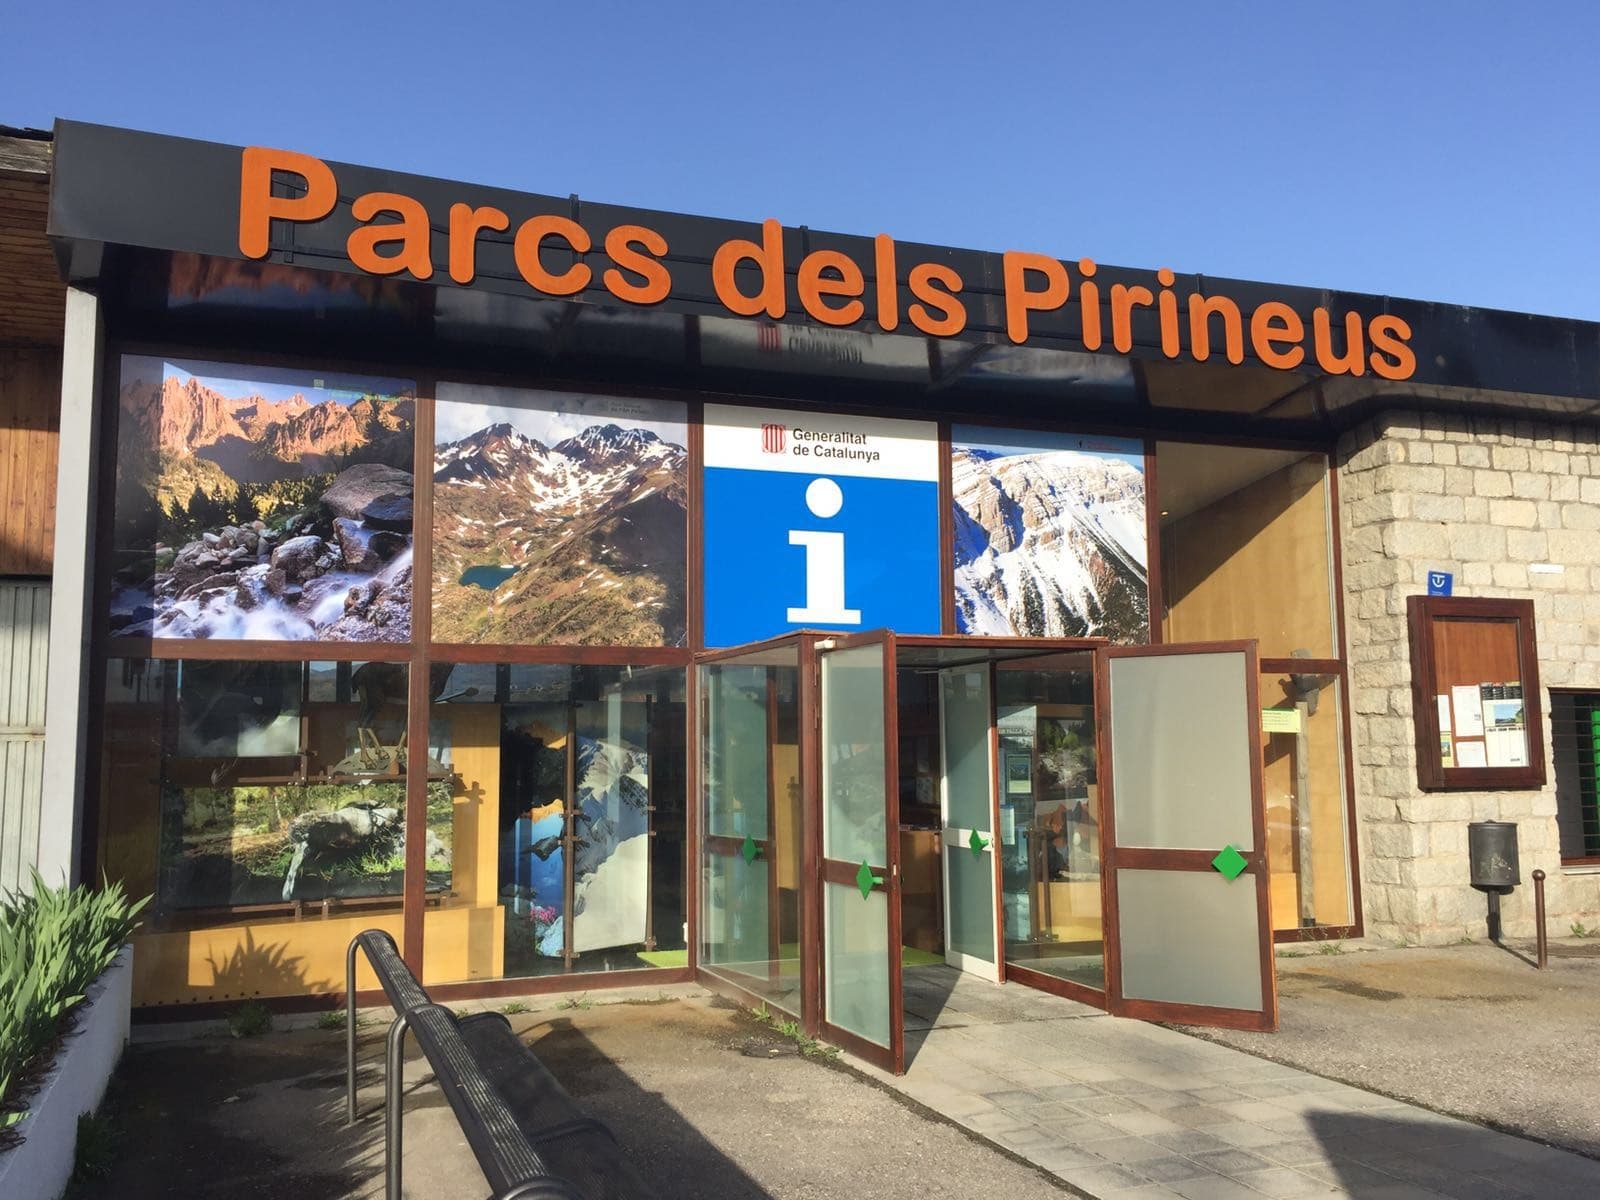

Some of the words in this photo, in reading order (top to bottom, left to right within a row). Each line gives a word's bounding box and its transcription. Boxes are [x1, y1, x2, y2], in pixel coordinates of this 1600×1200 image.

[239, 146, 672, 304] Parcs
[712, 219, 966, 336] dels
[1003, 252, 1418, 381] Pirineus
[793, 429, 867, 445] Generalitat
[793, 445, 809, 456] de
[814, 446, 880, 463] Catalunya
[787, 477, 862, 625] i
